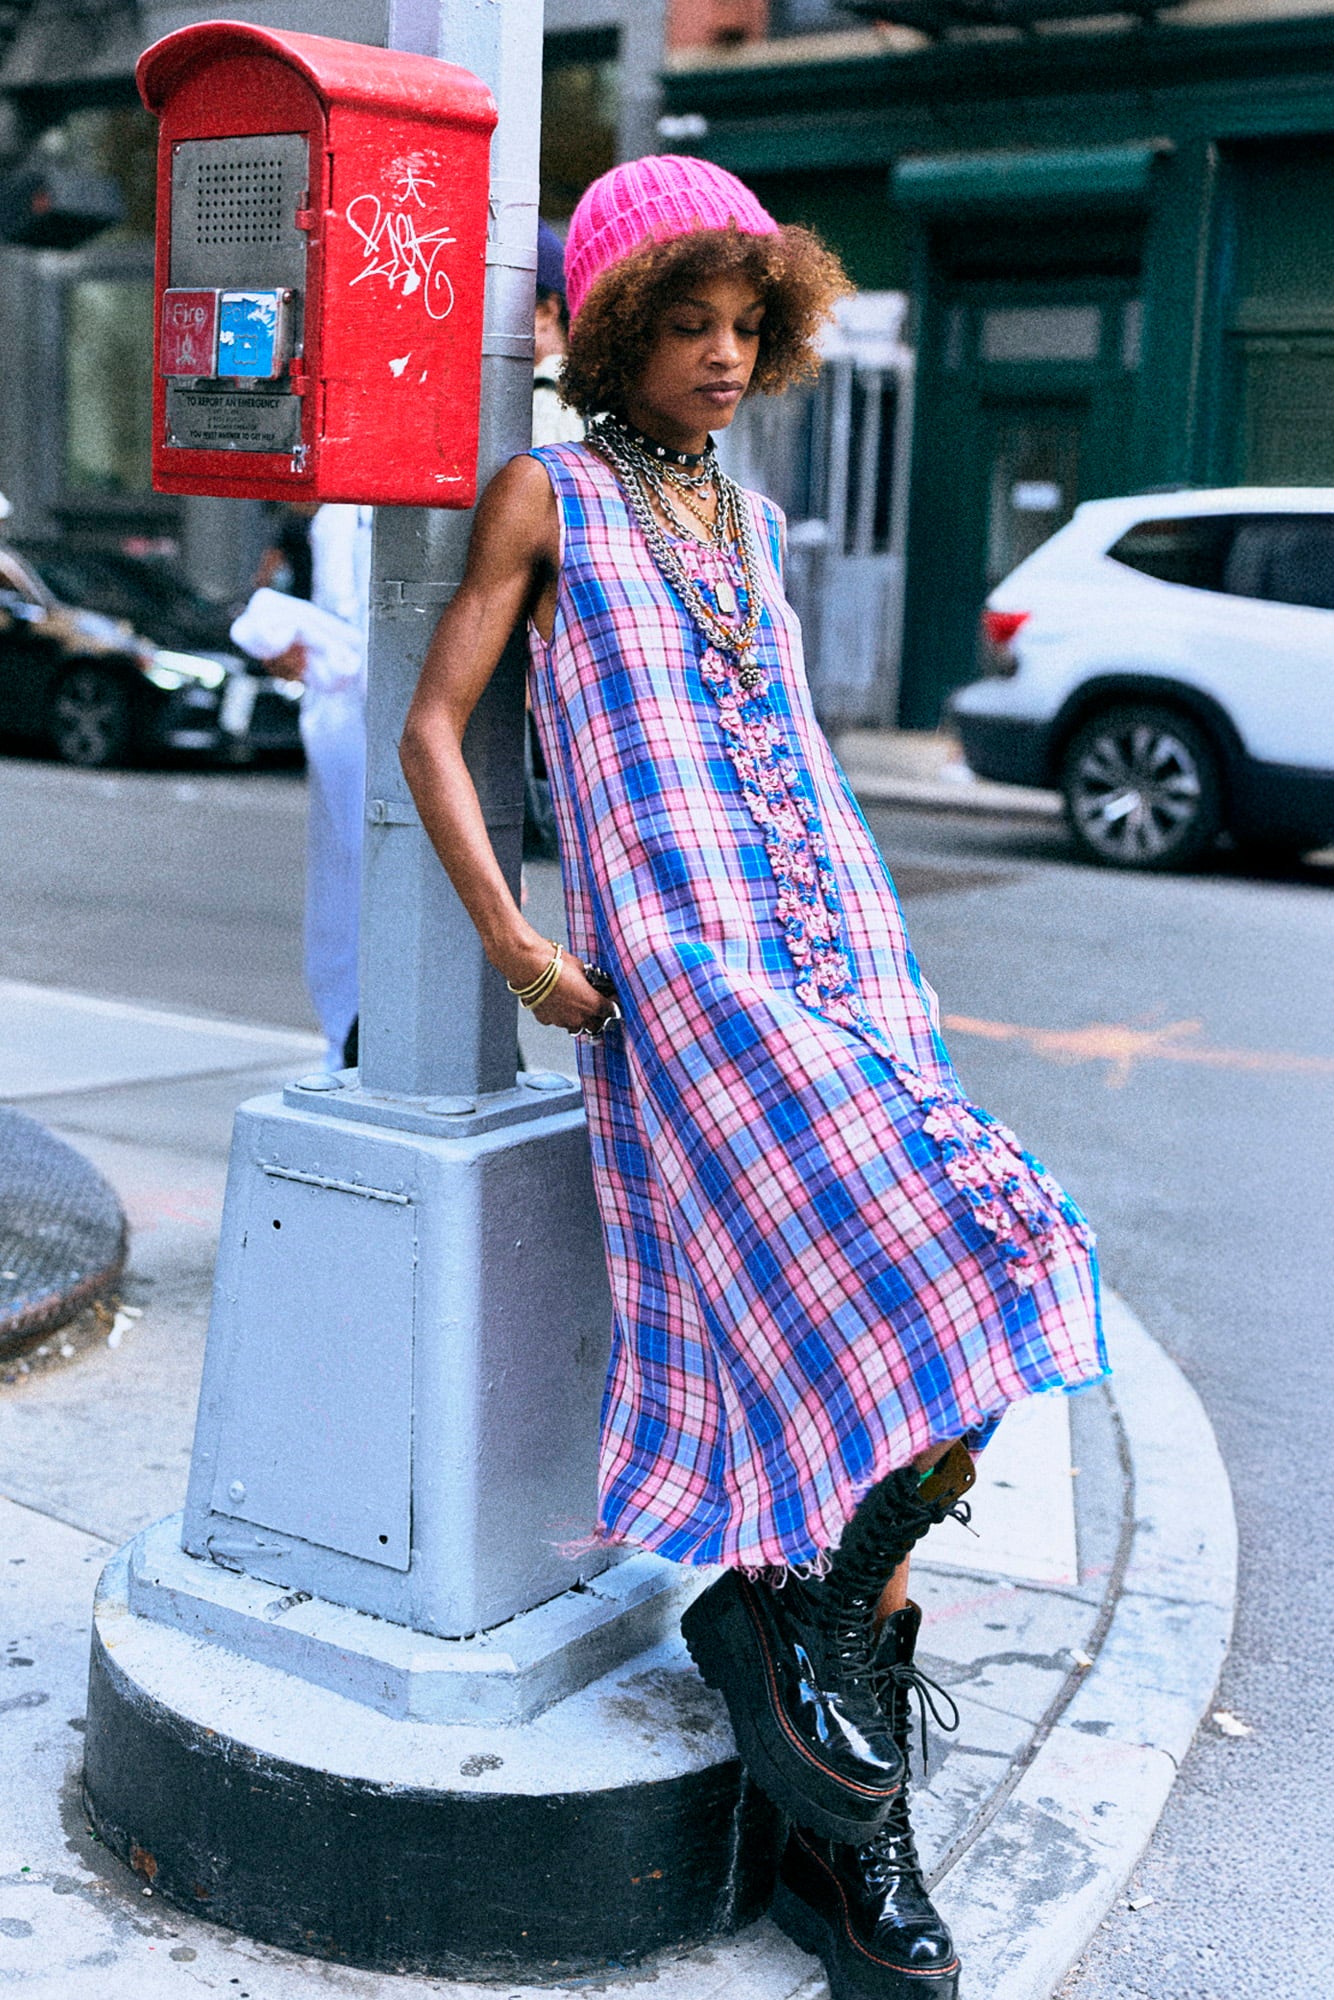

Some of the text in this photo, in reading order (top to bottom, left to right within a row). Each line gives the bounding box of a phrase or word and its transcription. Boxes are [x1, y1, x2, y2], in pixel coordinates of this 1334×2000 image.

[173, 303, 206, 323] Fire
[187, 396, 280, 409] TO REPORT AN EMERGENCY
